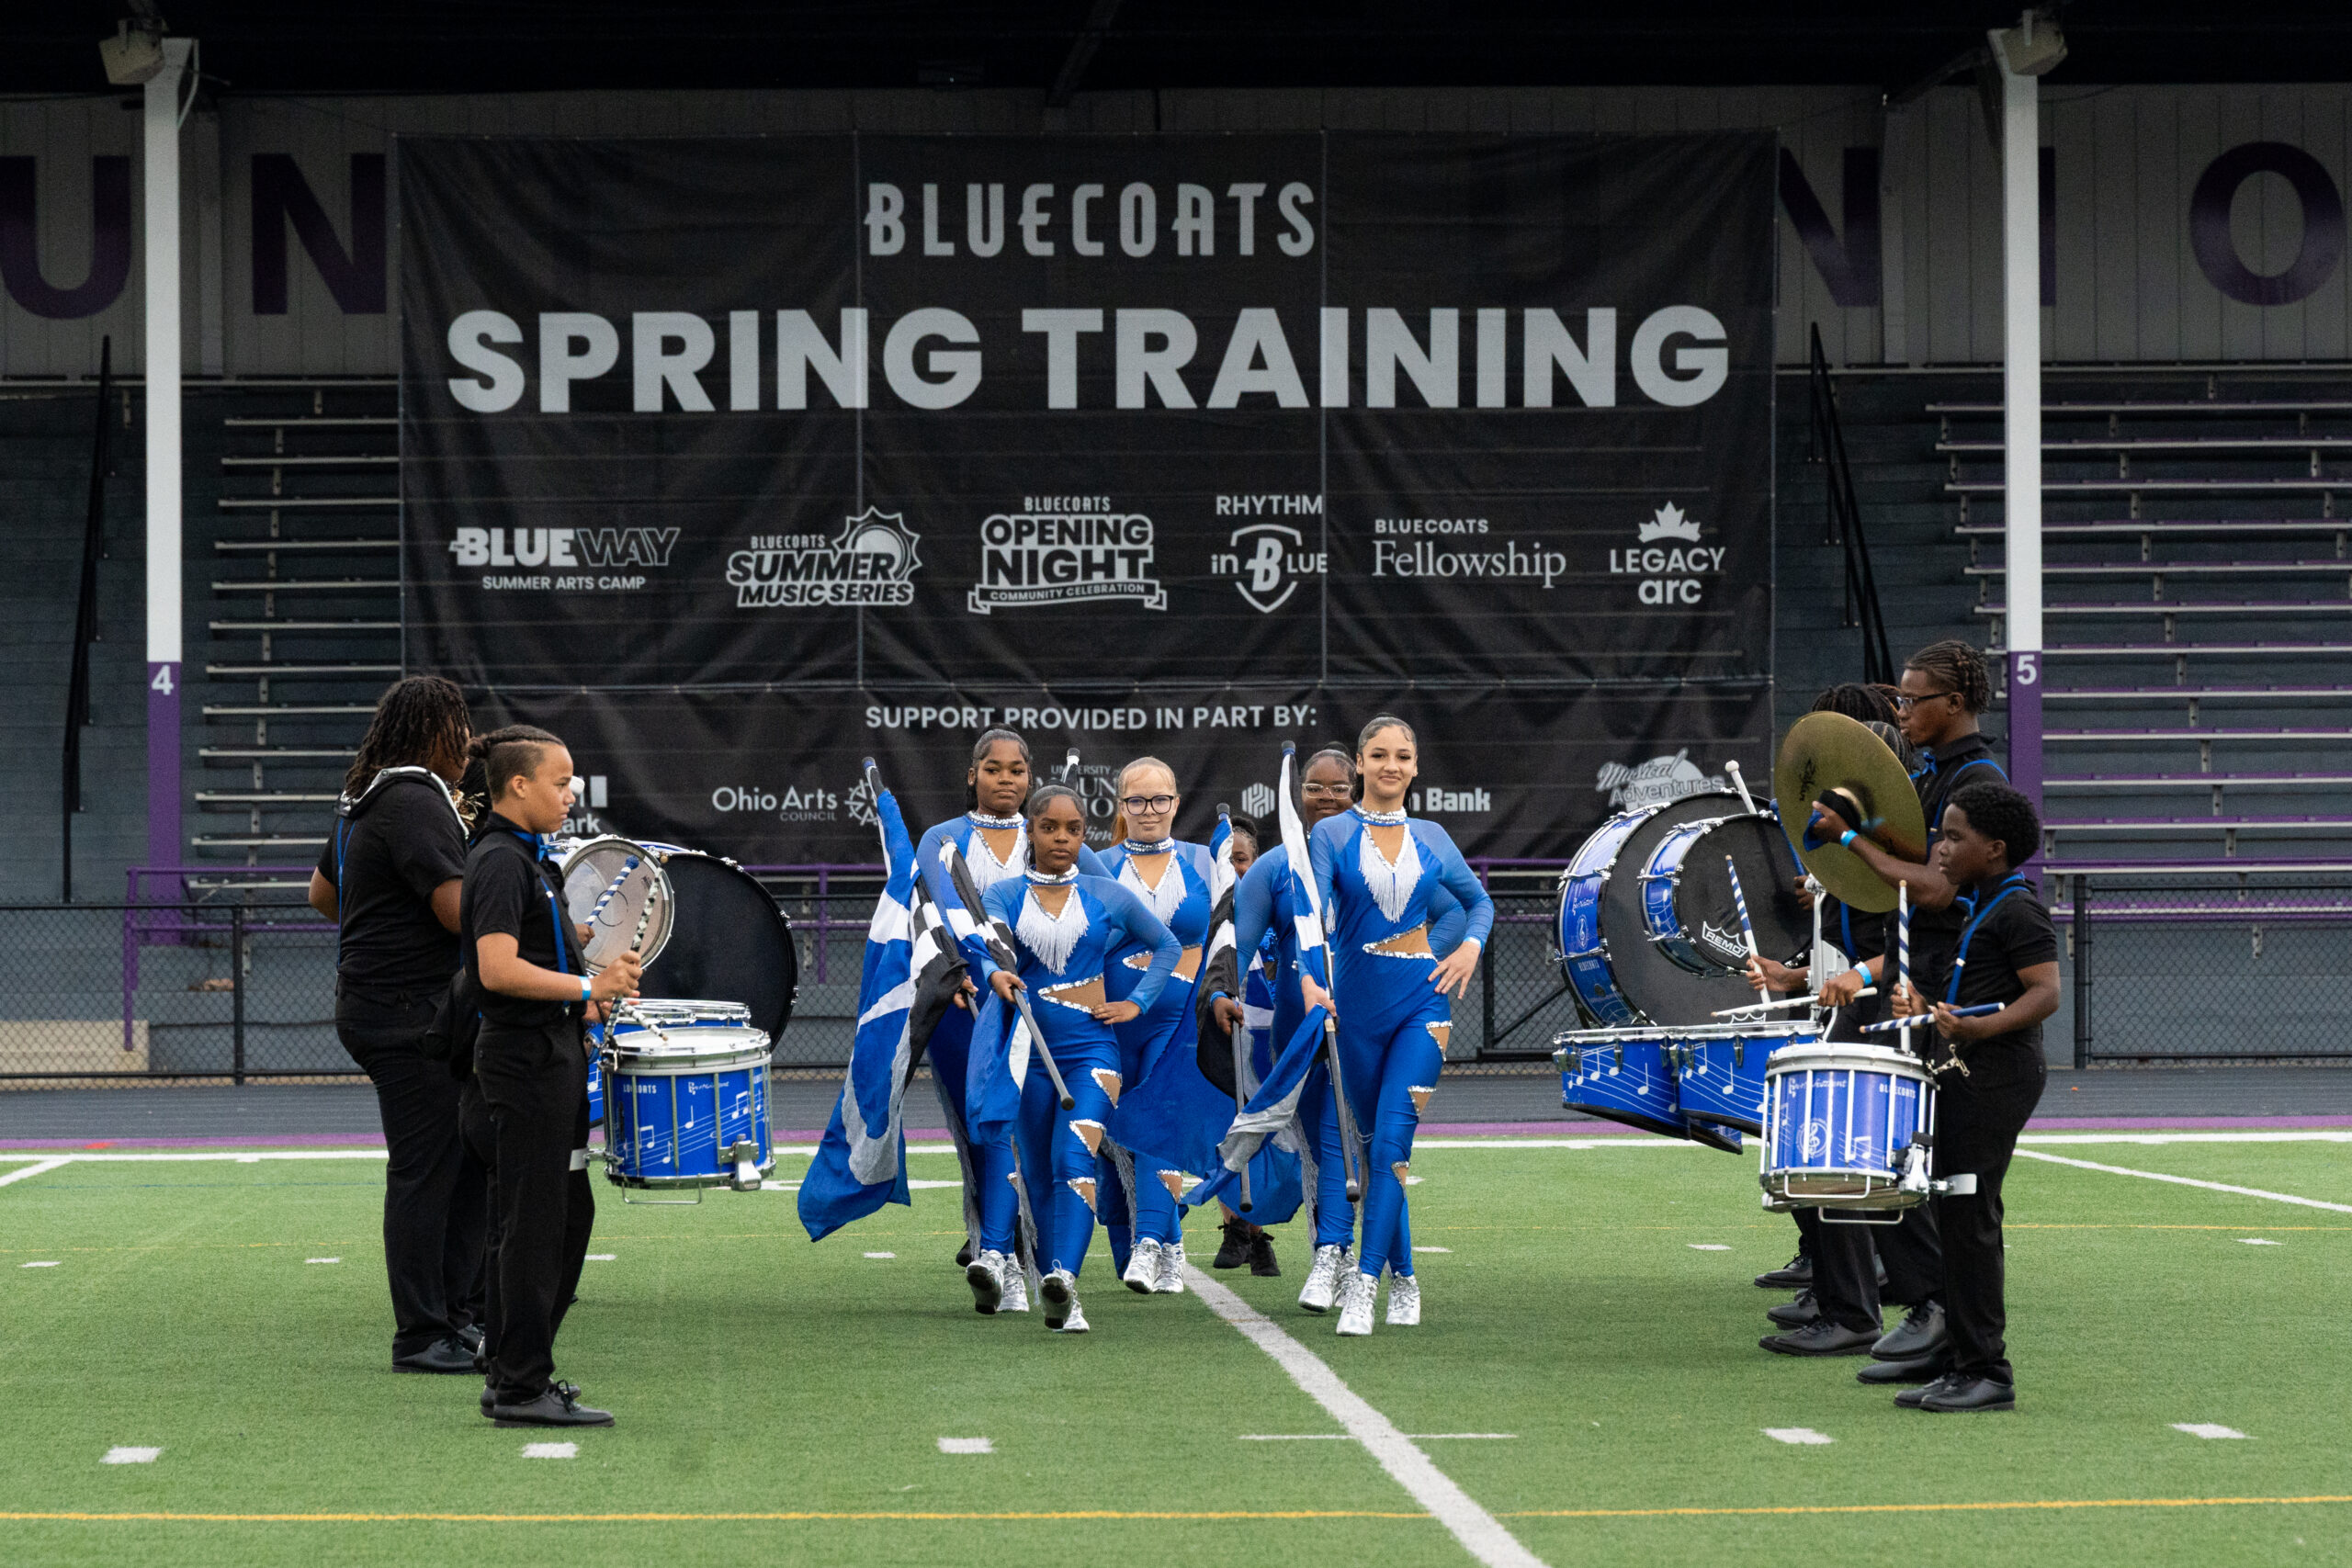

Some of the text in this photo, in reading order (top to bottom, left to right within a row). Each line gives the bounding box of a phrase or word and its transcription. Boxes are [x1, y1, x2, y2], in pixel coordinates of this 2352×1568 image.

[865, 182, 1317, 258] BLUECOATS
[447, 305, 1729, 413] SPRING TRAINING
[1024, 497, 1111, 512] BLUECOATS
[1216, 495, 1323, 515] RHYTHM
[984, 516, 1150, 547] OPENING
[1374, 519, 1489, 535] BLUECOATS
[751, 535, 826, 549] BLUECOATS
[727, 551, 896, 584] SUMMER
[986, 548, 1150, 586] NIGHT
[1211, 553, 1239, 574] in
[1372, 540, 1566, 588] Fellowship
[1610, 547, 1726, 573] LEGACY
[482, 575, 646, 590] SUMMER ARTS CAMP
[740, 582, 913, 604] MUSIC SERIES
[990, 583, 1146, 601] COMMUNITY CELEBRATION
[1638, 580, 1702, 604] arc
[152, 664, 175, 695] 4
[2017, 654, 2037, 685] 5
[865, 705, 1317, 730] SUPPORT PROVIDED IN PART BY:
[1596, 747, 1689, 792] Musical
[712, 784, 838, 811] Ohio Arts
[1426, 787, 1490, 812] Bank
[1609, 775, 1725, 807] Adventures
[780, 811, 838, 822] COUNCIL
[1705, 931, 1742, 954] REMO
